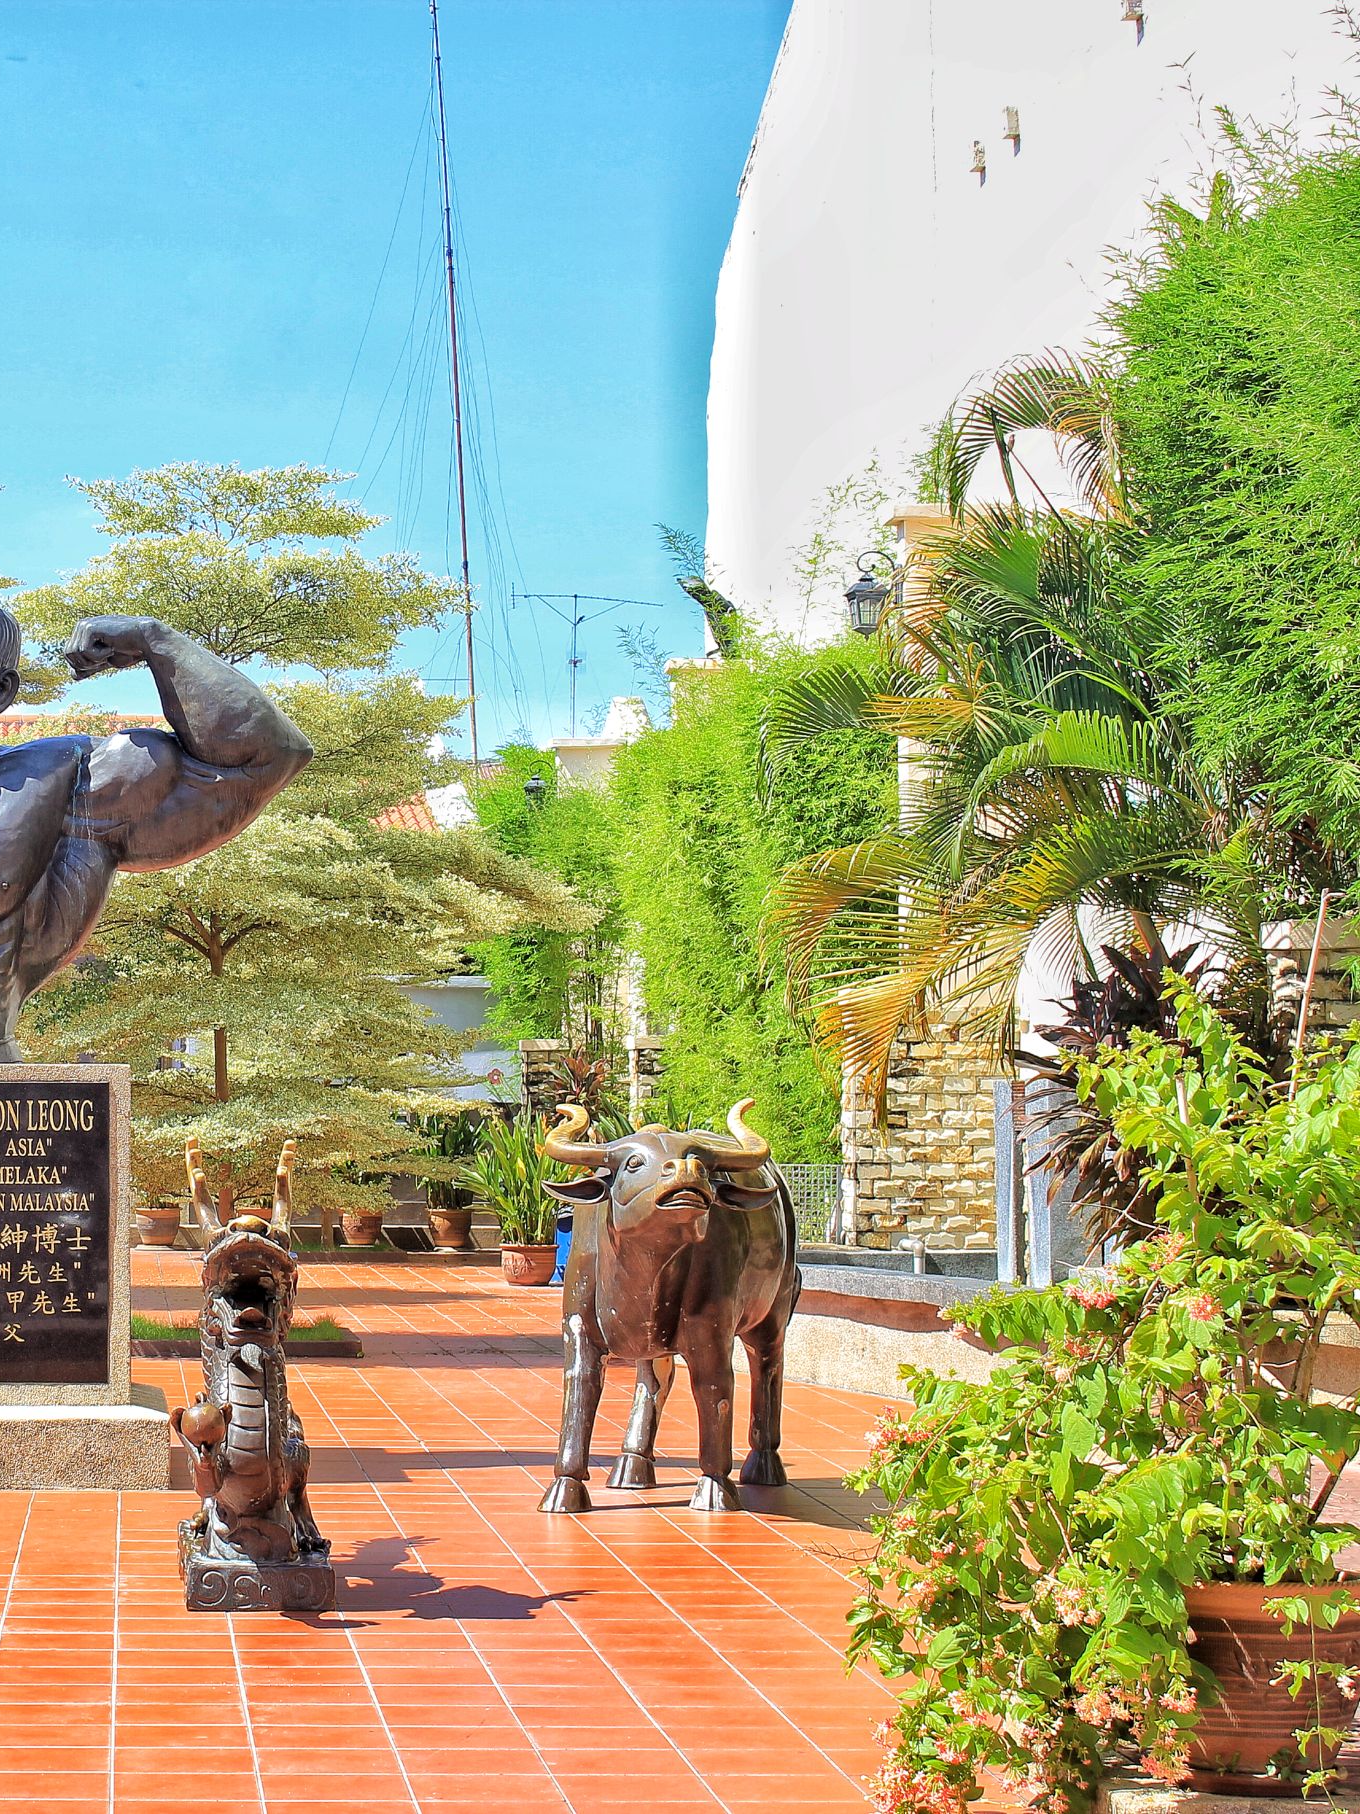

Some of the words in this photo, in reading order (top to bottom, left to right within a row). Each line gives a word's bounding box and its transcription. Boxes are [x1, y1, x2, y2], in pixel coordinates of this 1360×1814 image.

[27, 1099, 94, 1132] LEONG
[5, 1137, 52, 1157] ASIA"
[10, 1192, 95, 1212] MALAYSIA"
